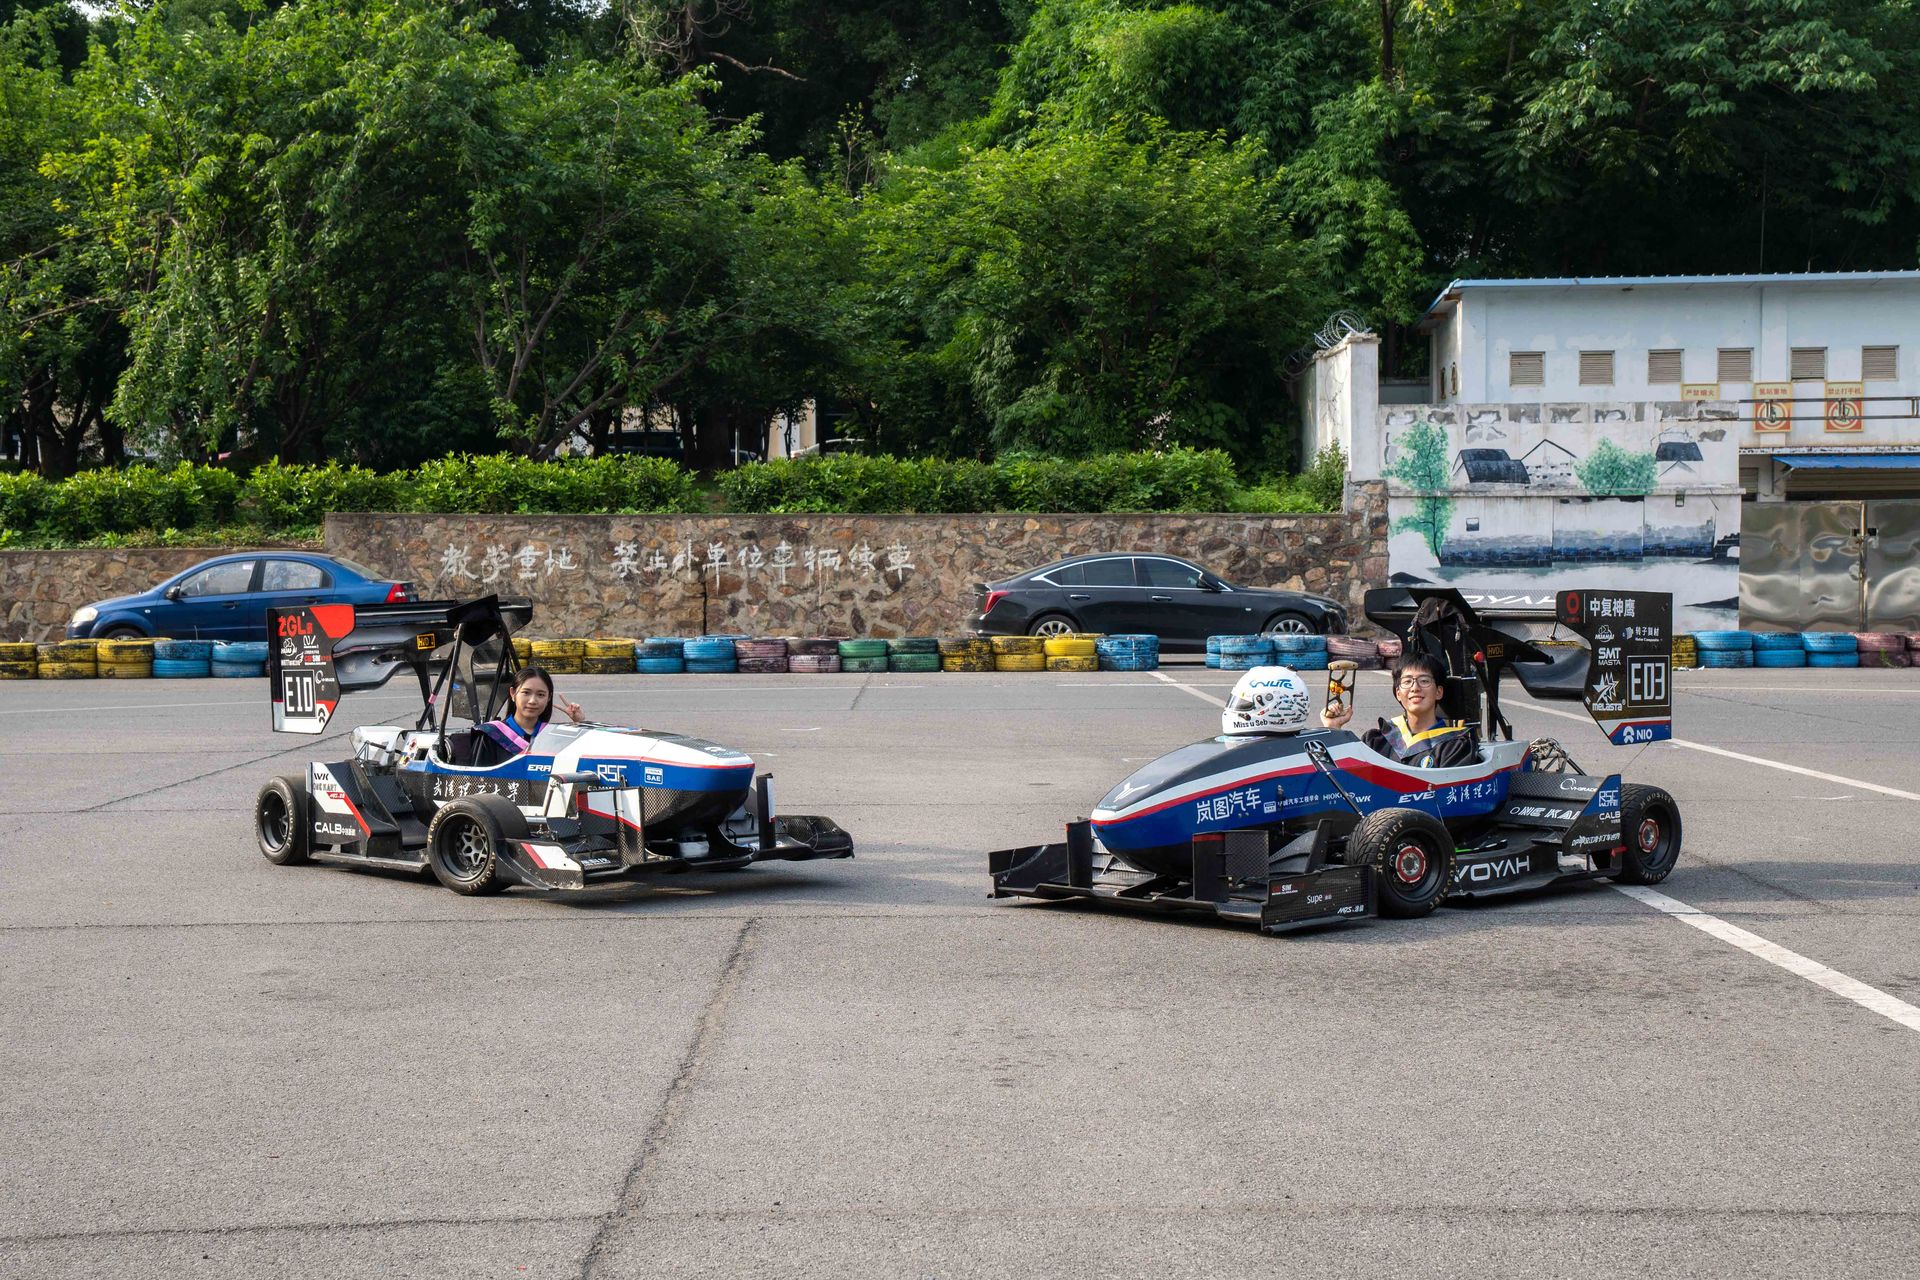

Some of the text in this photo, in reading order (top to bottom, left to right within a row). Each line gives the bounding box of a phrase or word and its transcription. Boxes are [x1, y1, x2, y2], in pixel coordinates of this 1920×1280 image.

[1589, 598, 1635, 617] 中复神鹰
[1598, 647, 1621, 659] SMT
[1255, 719, 1268, 727] Seb
[1636, 729, 1653, 740] NIO
[1398, 791, 1435, 803] EVE
[1196, 788, 1261, 824] 岚图汽车
[1599, 811, 1621, 820] CALB
[314, 821, 342, 835] CALB
[1454, 855, 1530, 883] VOYAH
